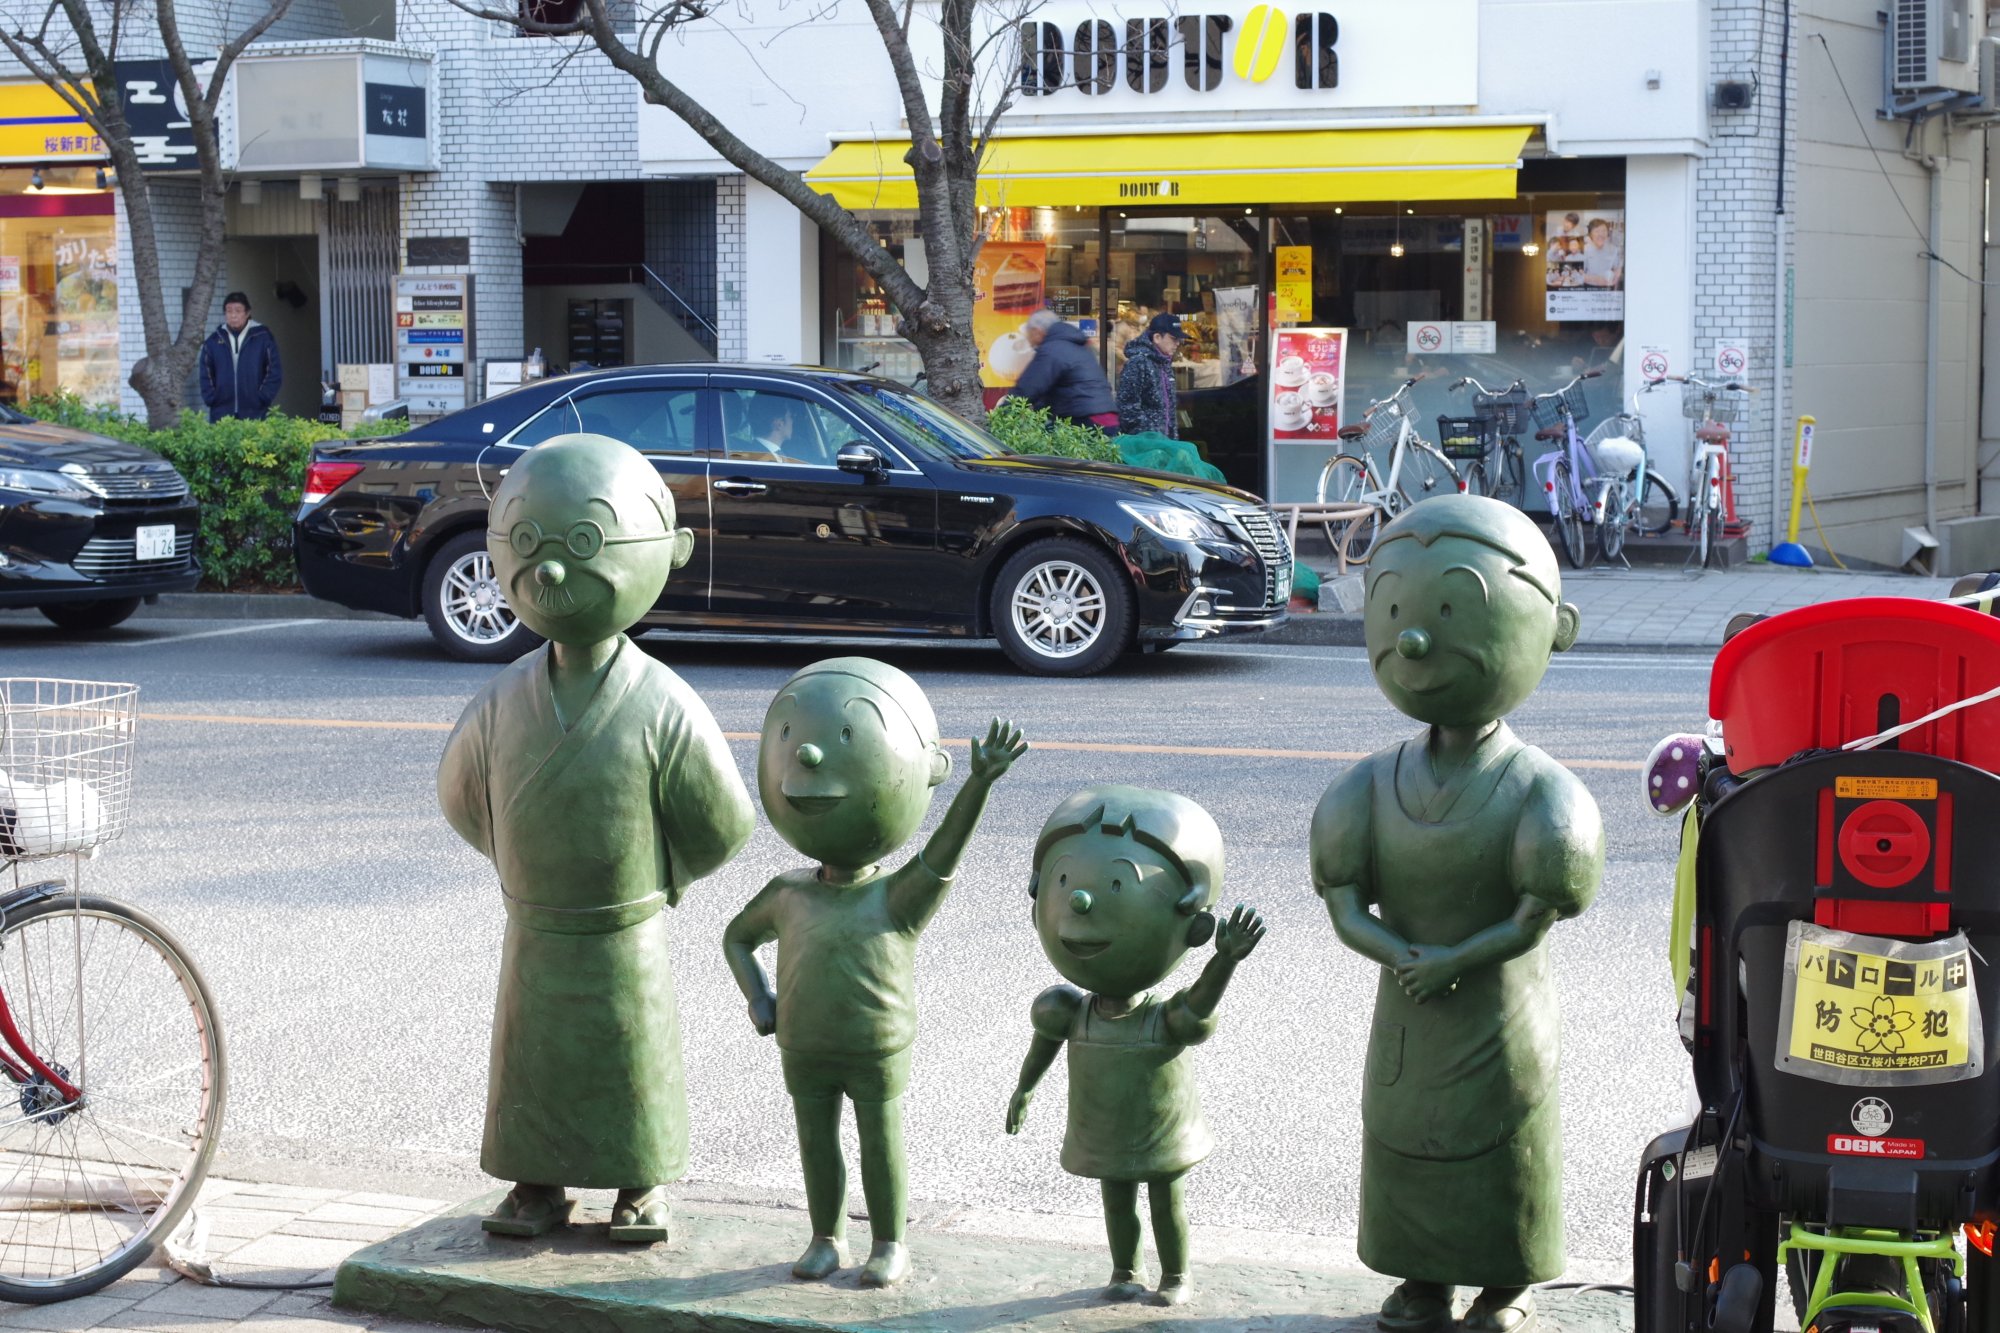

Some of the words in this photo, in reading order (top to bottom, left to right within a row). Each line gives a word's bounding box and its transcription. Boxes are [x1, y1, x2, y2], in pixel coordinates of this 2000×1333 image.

[1021, 4, 1339, 97] DOUTOR
[1119, 180, 1179, 198] DOUTOR
[420, 364, 453, 375] DOUTOR
[1804, 955, 1964, 988] パトロール中
[1813, 1047, 1945, 1068] 世田谷区立桜小学校PTA
[1834, 1137, 1886, 1154] OGK
